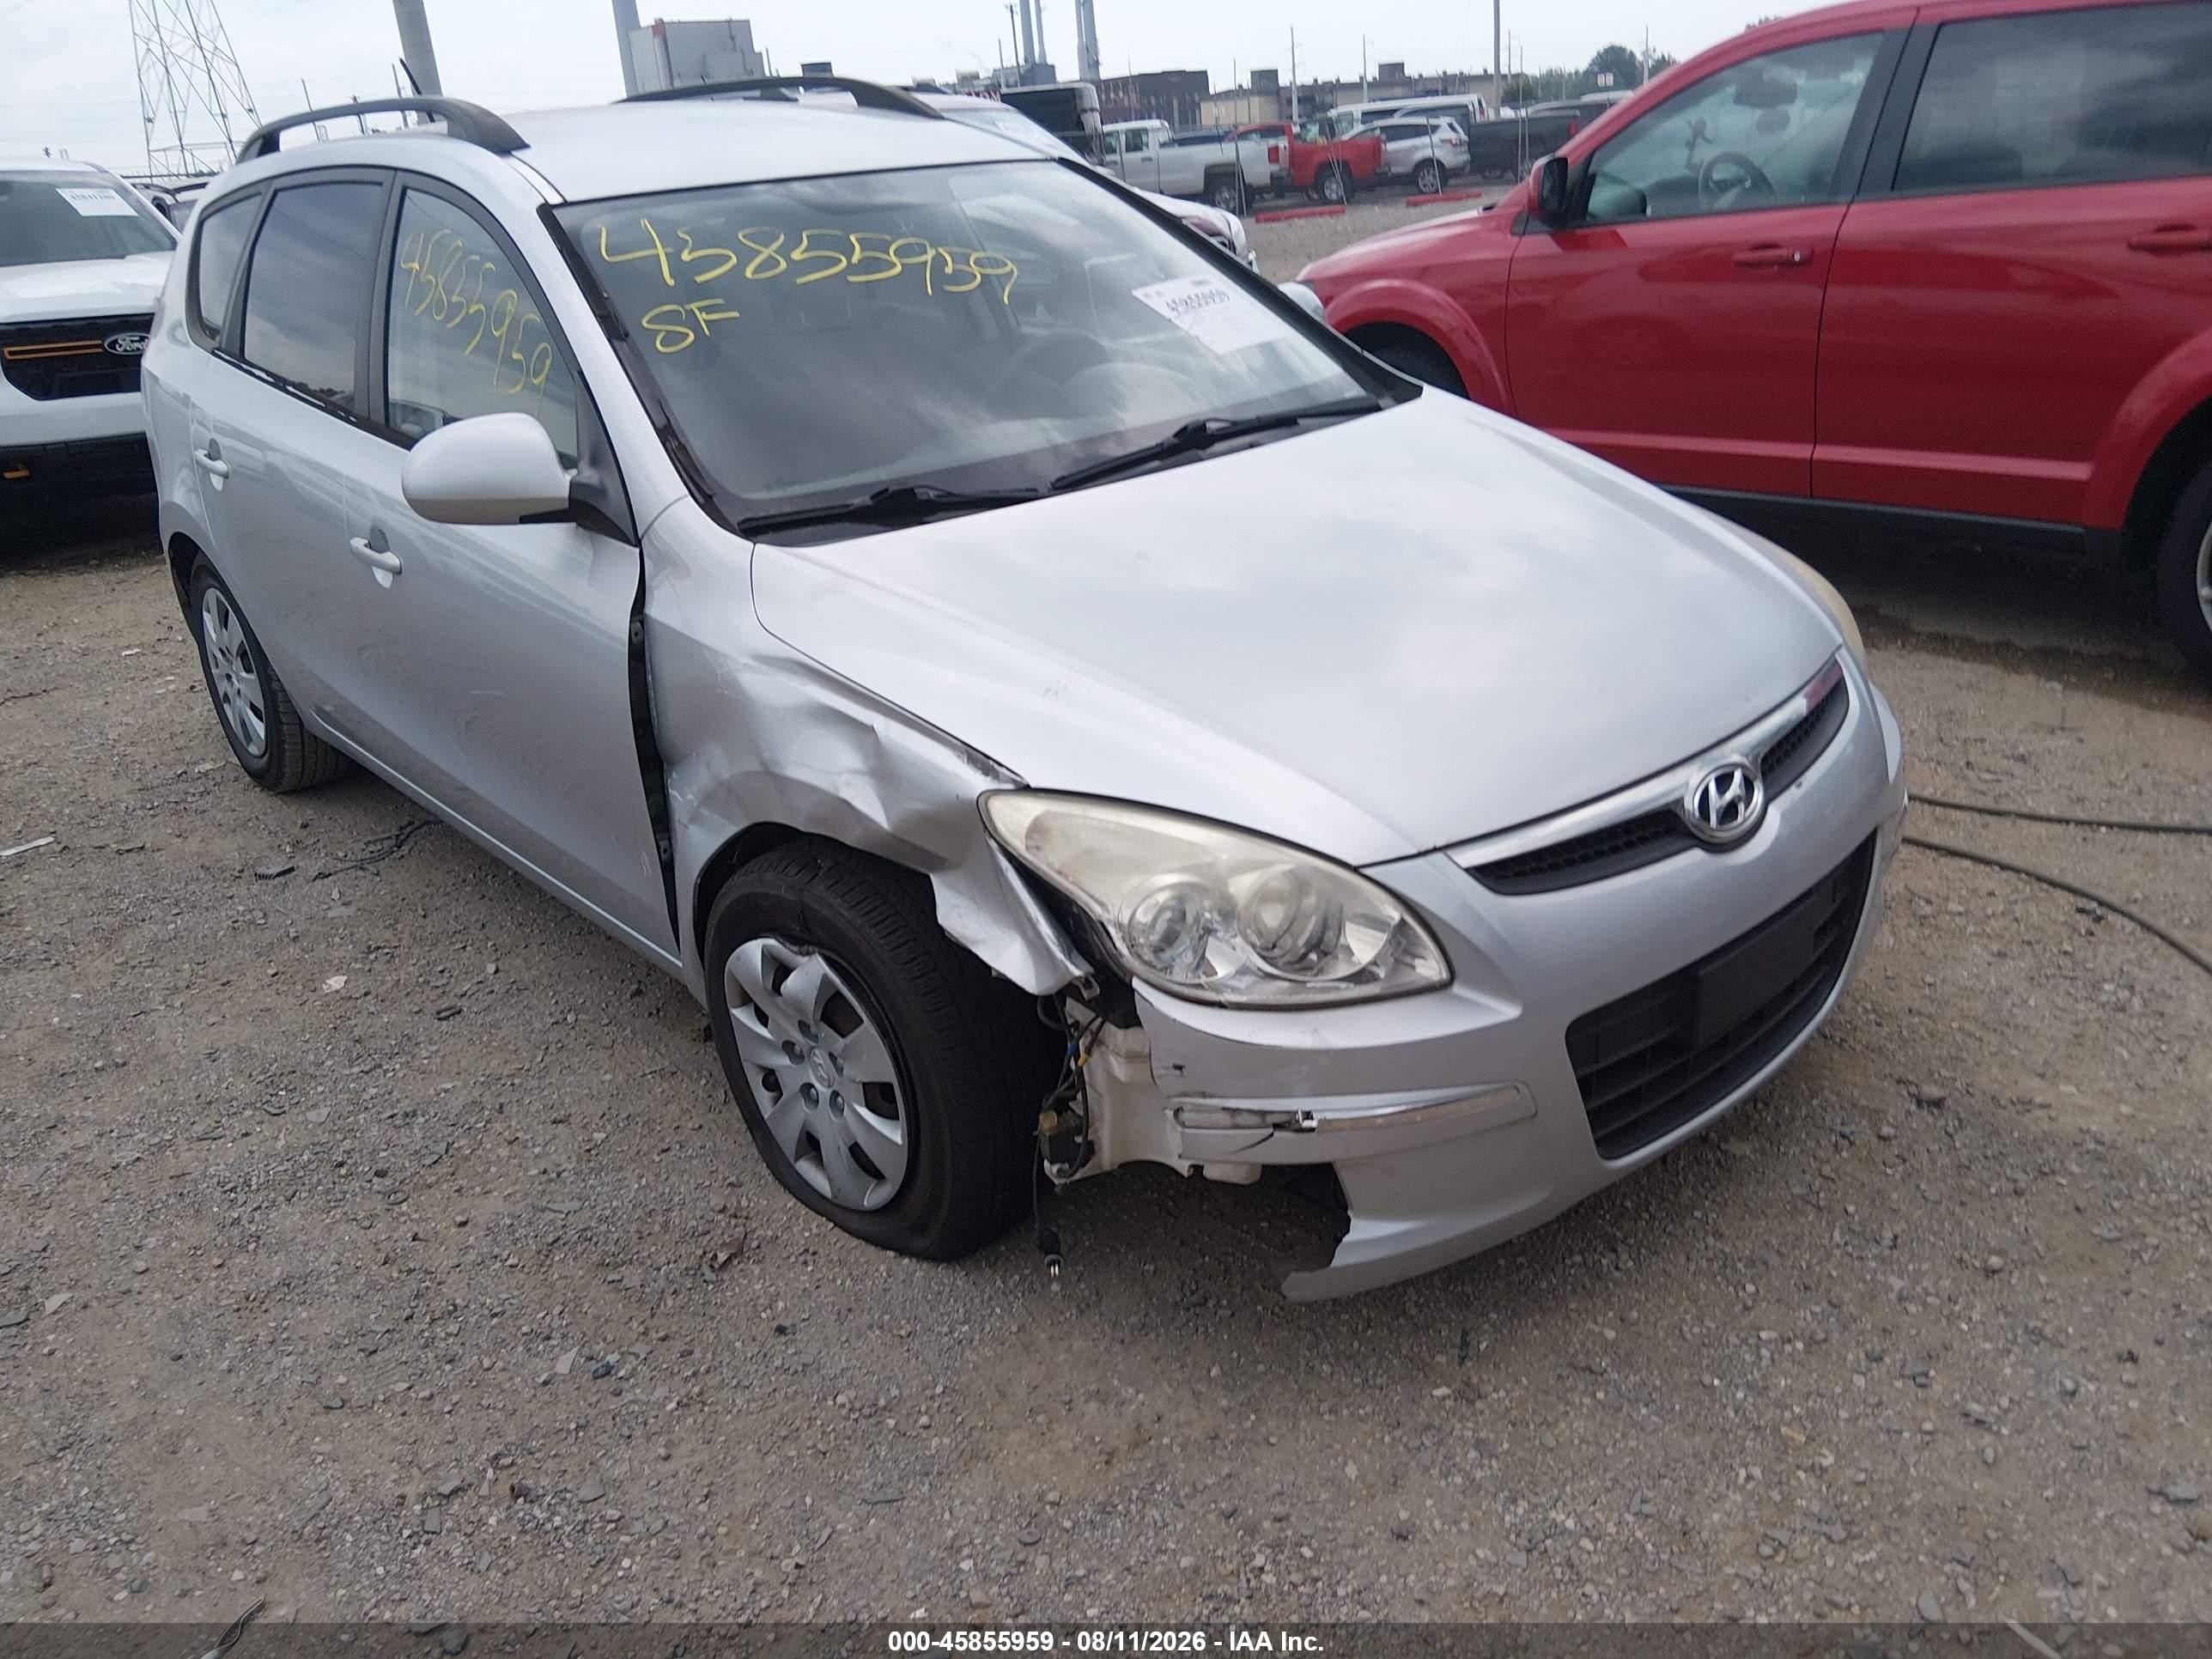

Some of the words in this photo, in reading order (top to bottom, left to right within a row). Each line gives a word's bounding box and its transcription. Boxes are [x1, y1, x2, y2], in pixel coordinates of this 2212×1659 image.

[599, 218, 1019, 305] 45855959
[115, 336, 149, 352] Ford
[400, 228, 553, 416] 45855959
